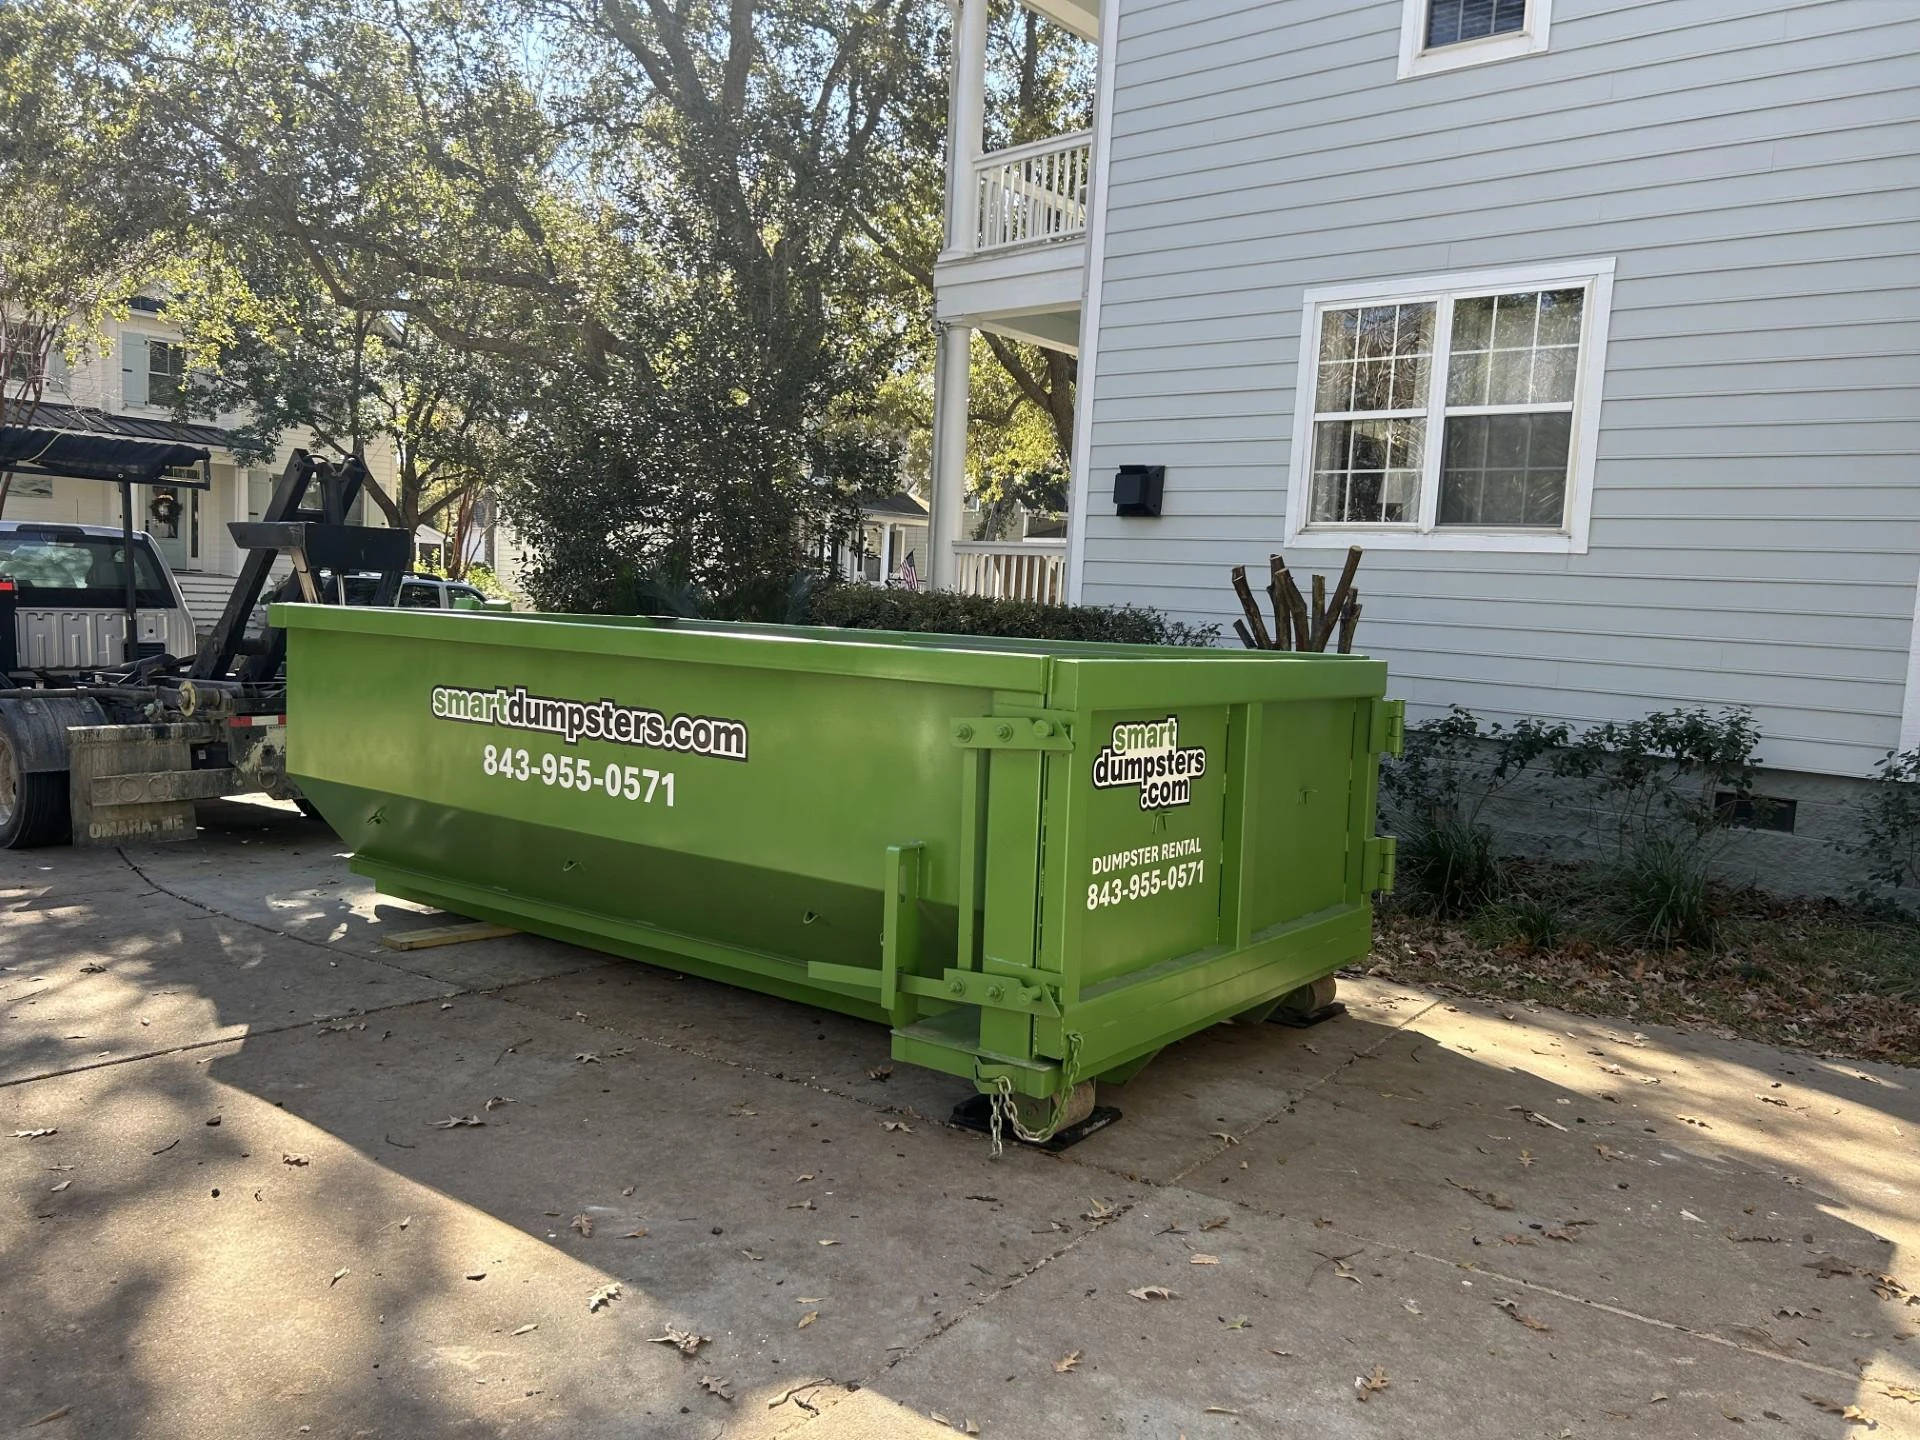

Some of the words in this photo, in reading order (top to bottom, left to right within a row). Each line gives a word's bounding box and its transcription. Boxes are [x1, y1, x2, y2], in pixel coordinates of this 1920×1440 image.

[432, 687, 747, 760] smartdumpsters.com
[1112, 717, 1177, 753] smart
[483, 744, 675, 807] 843-955-0571
[1094, 749, 1206, 786] dumpsters
[1140, 776, 1190, 808] .com
[1092, 845, 1159, 875] DUMPSTER
[1161, 837, 1202, 862] RENTAL
[1086, 859, 1205, 910] 843-955-0571
